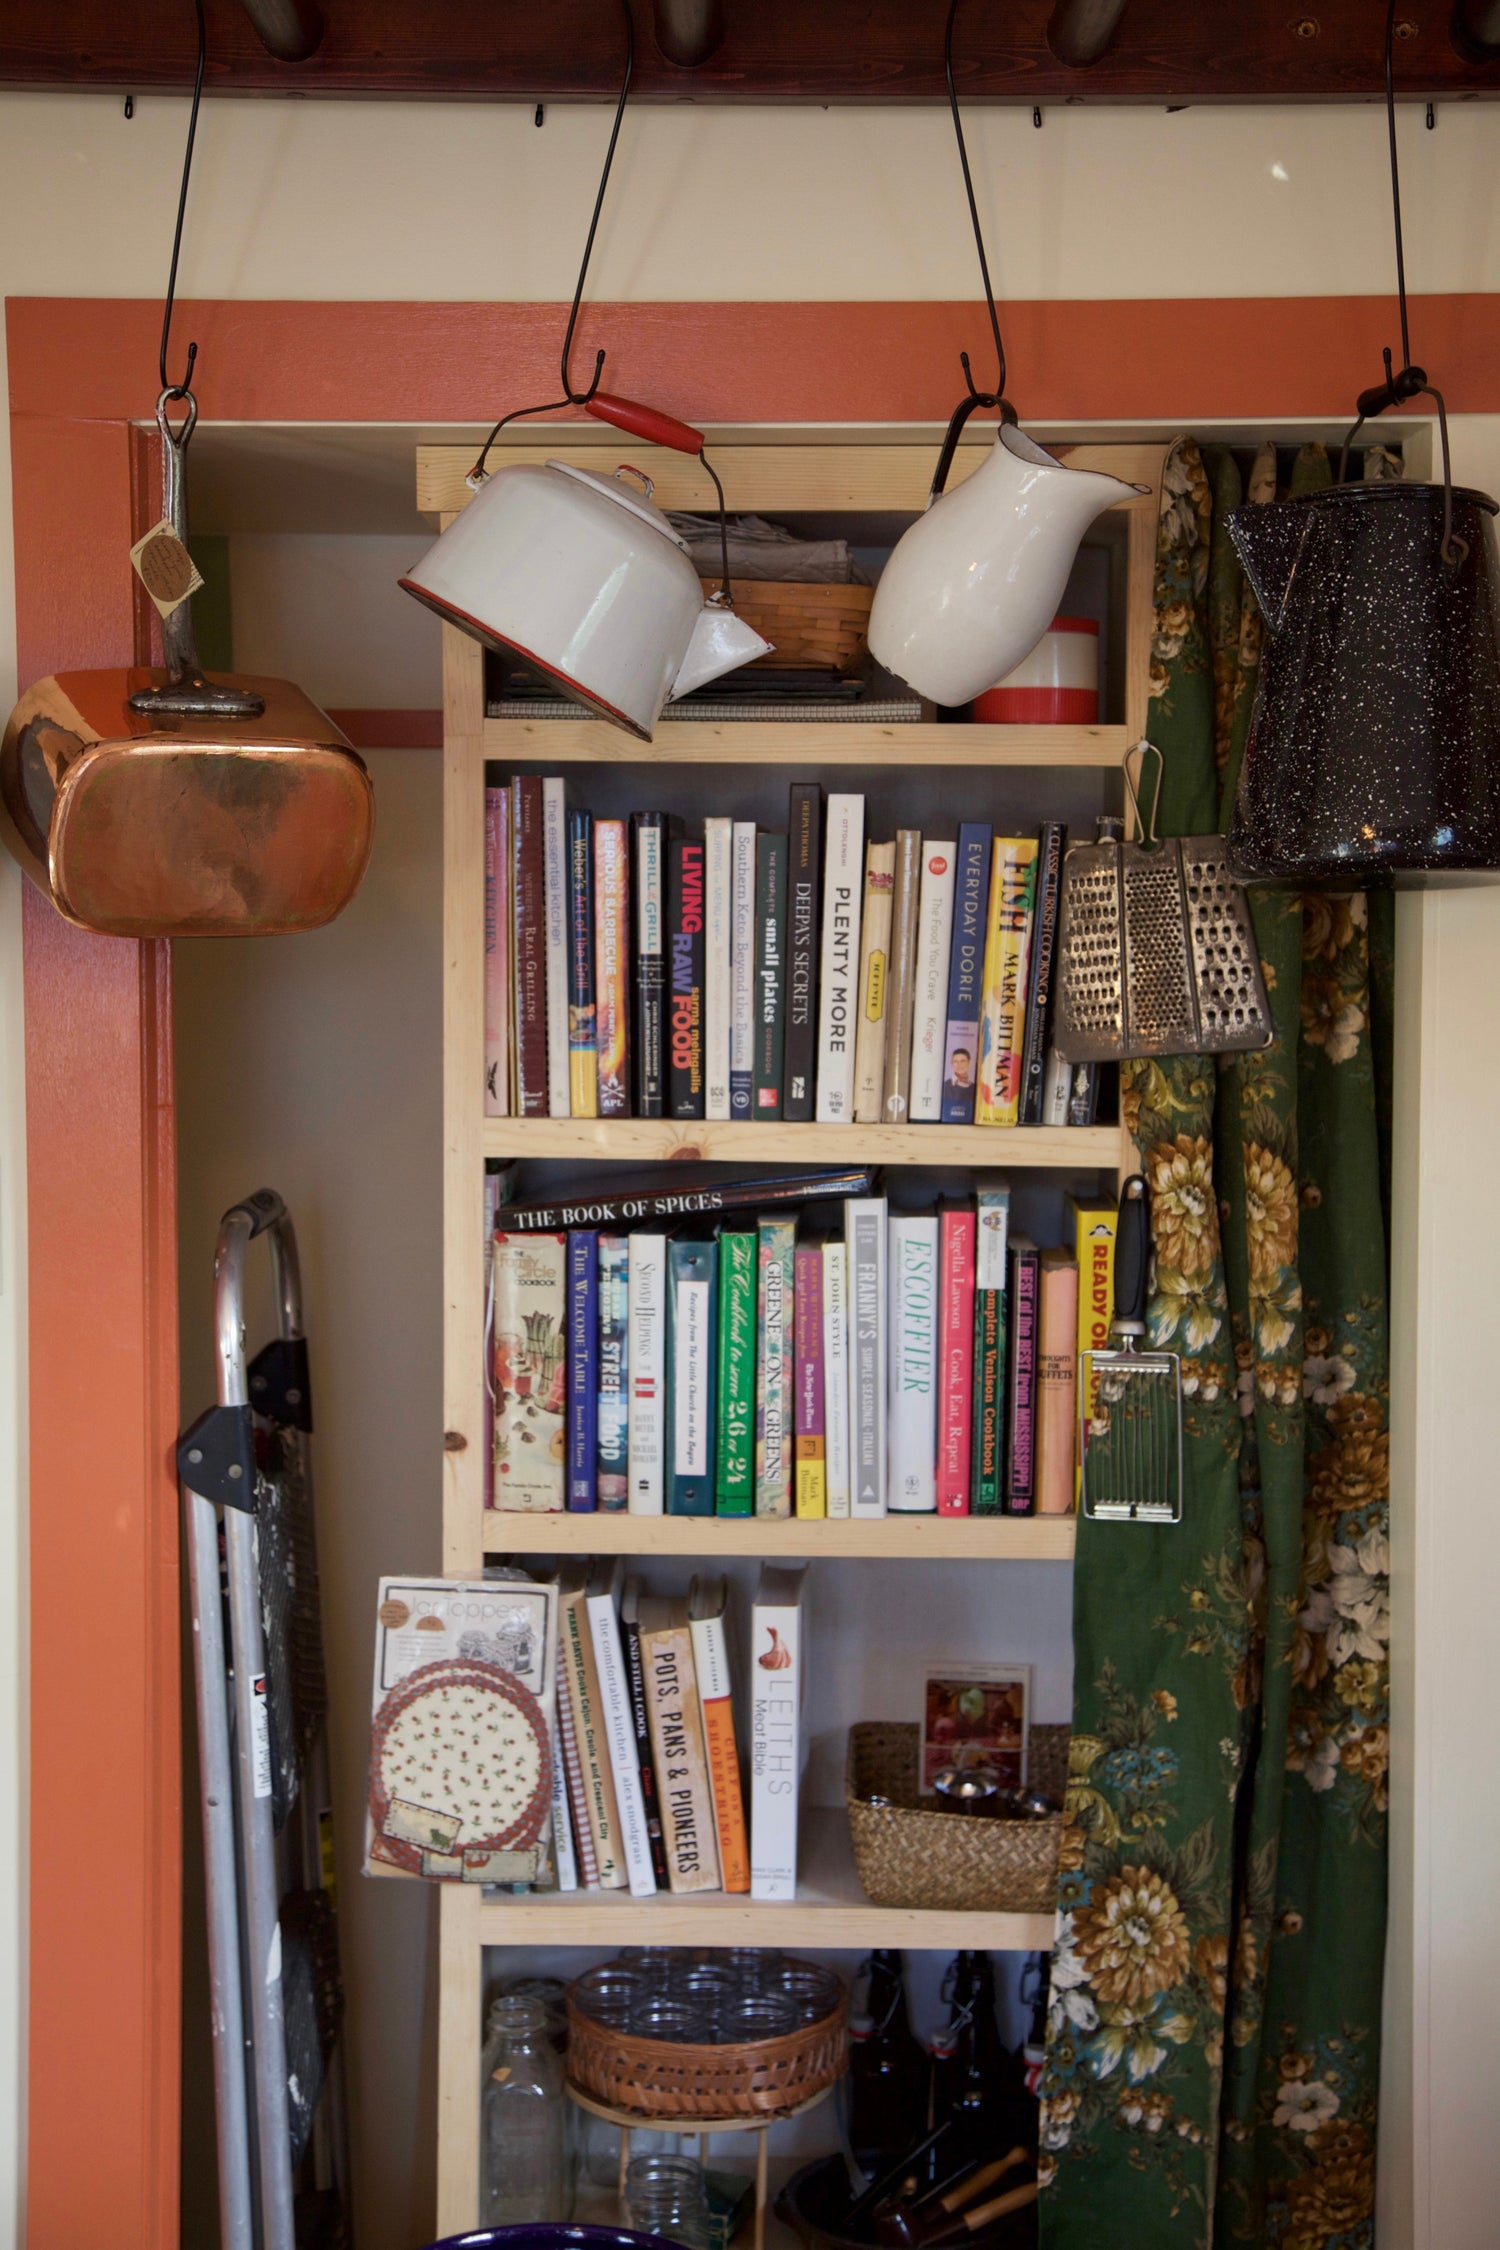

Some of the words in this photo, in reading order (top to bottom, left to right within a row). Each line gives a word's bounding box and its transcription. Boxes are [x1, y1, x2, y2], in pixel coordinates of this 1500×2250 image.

[547, 800, 558, 823] the
[801, 801, 811, 828] DEEPA
[549, 827, 561, 891] essential
[604, 831, 617, 893] SERIOUS
[647, 831, 657, 890] THRILL
[768, 852, 776, 867] THE
[801, 830, 810, 868] THOMAS
[841, 818, 849, 868] OTTOLENGHI
[1047, 835, 1061, 879] CLASSIC
[574, 838, 587, 890] Weber's
[737, 836, 751, 900] Southern
[575, 894, 587, 914] Art
[682, 847, 702, 933] LIVING
[767, 869, 777, 913] COMPLETE
[933, 898, 943, 916] The
[964, 843, 982, 937] EVERYDAY
[999, 859, 1032, 934] FISH
[1043, 883, 1058, 933] TURKISH
[551, 894, 563, 947] kitchen
[575, 919, 587, 932] of
[647, 901, 657, 951] GRILL
[795, 883, 812, 946] DEEPA'S
[833, 887, 851, 977] PLENTY
[930, 920, 943, 945] Food
[526, 926, 537, 957] REAL
[576, 937, 588, 957] the
[605, 897, 618, 975] BARBECUE
[765, 918, 780, 966] small
[576, 962, 589, 989] Grill
[672, 934, 693, 992] RAW
[734, 942, 750, 992] Beyond
[929, 948, 942, 967] You
[958, 945, 976, 1003] DORIE
[1037, 934, 1052, 994] COOKING
[527, 960, 538, 1022] GRILLING
[761, 971, 780, 1024] plates
[792, 951, 810, 1024] SECRETS
[927, 969, 940, 1001] Crave
[1001, 951, 1019, 1007] MARK
[690, 986, 701, 1025] sarma
[736, 997, 748, 1018] the
[830, 987, 848, 1053] MORE
[672, 995, 693, 1069] FOOD
[735, 1023, 748, 1065] Basics
[765, 1027, 773, 1074] COOKBOOK
[922, 1017, 937, 1054] Krieger
[995, 1015, 1014, 1098] BITTMAN
[602, 1099, 624, 1108] APL
[514, 1210, 556, 1229] THE
[562, 1203, 616, 1225] BOOK
[622, 1199, 649, 1218] OF
[655, 1192, 723, 1215] SPICES
[575, 1247, 588, 1275] THE
[731, 1236, 752, 1271] The
[831, 1255, 841, 1273] ST.
[949, 1226, 966, 1273] Nigella
[516, 1279, 556, 1287] COOKBOOK
[635, 1262, 656, 1304] SECOND
[811, 1259, 819, 1290] MARK
[1019, 1267, 1033, 1298] BEST
[1091, 1244, 1109, 1317] READY
[573, 1279, 588, 1347] WELCOME
[687, 1292, 698, 1321] Recipes
[729, 1269, 751, 1348] Cookbook
[767, 1261, 782, 1335] GREENE
[831, 1278, 841, 1314] JOHN
[857, 1263, 877, 1340] FRANNY'S
[951, 1277, 966, 1329] Lawson
[1019, 1301, 1032, 1314] of
[635, 1307, 656, 1358] HELPINGS
[688, 1324, 698, 1342] from
[904, 1238, 933, 1394] ESCOFFIER
[985, 1289, 998, 1344] omplete
[1019, 1316, 1032, 1337] the
[690, 1345, 698, 1358] The
[730, 1347, 743, 1362] to
[831, 1317, 842, 1360] STYLE
[1018, 1341, 1031, 1371] BEST
[574, 1351, 588, 1393] TABLE
[601, 1341, 621, 1405] STREET
[689, 1361, 698, 1381] Little
[729, 1363, 740, 1398] serve
[766, 1356, 782, 1384] ON
[805, 1364, 814, 1376] The
[805, 1376, 815, 1391] New
[949, 1348, 964, 1389] Cook,
[984, 1349, 997, 1403] Venison
[688, 1384, 697, 1411] Church
[803, 1391, 815, 1408] York
[948, 1394, 964, 1421] Eat,
[1017, 1373, 1031, 1404] from
[601, 1414, 621, 1460] FOOD
[688, 1425, 697, 1438] the
[804, 1408, 815, 1429] Times
[686, 1440, 697, 1466] Bayou
[728, 1438, 738, 1453] or
[766, 1409, 781, 1480] GREENS
[945, 1426, 963, 1474] Repeat
[983, 1407, 996, 1475] Cookbook
[1014, 1408, 1030, 1487] MISSISSIPPI
[727, 1457, 748, 1484] 24
[801, 1470, 811, 1506] Bittman
[811, 1476, 819, 1499] Mark
[410, 1597, 439, 1616] Jar
[567, 1607, 581, 1639] FRANK
[599, 1618, 609, 1638] the
[629, 1635, 640, 1660] AND
[571, 1641, 584, 1668] DAVIS
[576, 1670, 588, 1696] Cooks
[602, 1640, 622, 1713] comfortable
[633, 1662, 644, 1696] STILL
[654, 1652, 680, 1703] POTS,
[612, 1715, 628, 1761] kitchen
[636, 1704, 647, 1739] COOK
[660, 1711, 687, 1758] PANS
[754, 1700, 768, 1738] Meat
[768, 1680, 794, 1795] LEITHS
[590, 1763, 602, 1780] and
[667, 1768, 689, 1781] &
[725, 1737, 741, 1786] CHEF
[754, 1742, 768, 1777] Bible
[593, 1781, 607, 1820] Crescent
[622, 1777, 634, 1801] alex
[708, 1719, 732, 1846] SHOESTRING
[554, 1804, 567, 1853] service
[599, 1822, 609, 1840] City
[627, 1804, 642, 1865] snodgrass
[669, 1789, 700, 1874] PIONEERS
